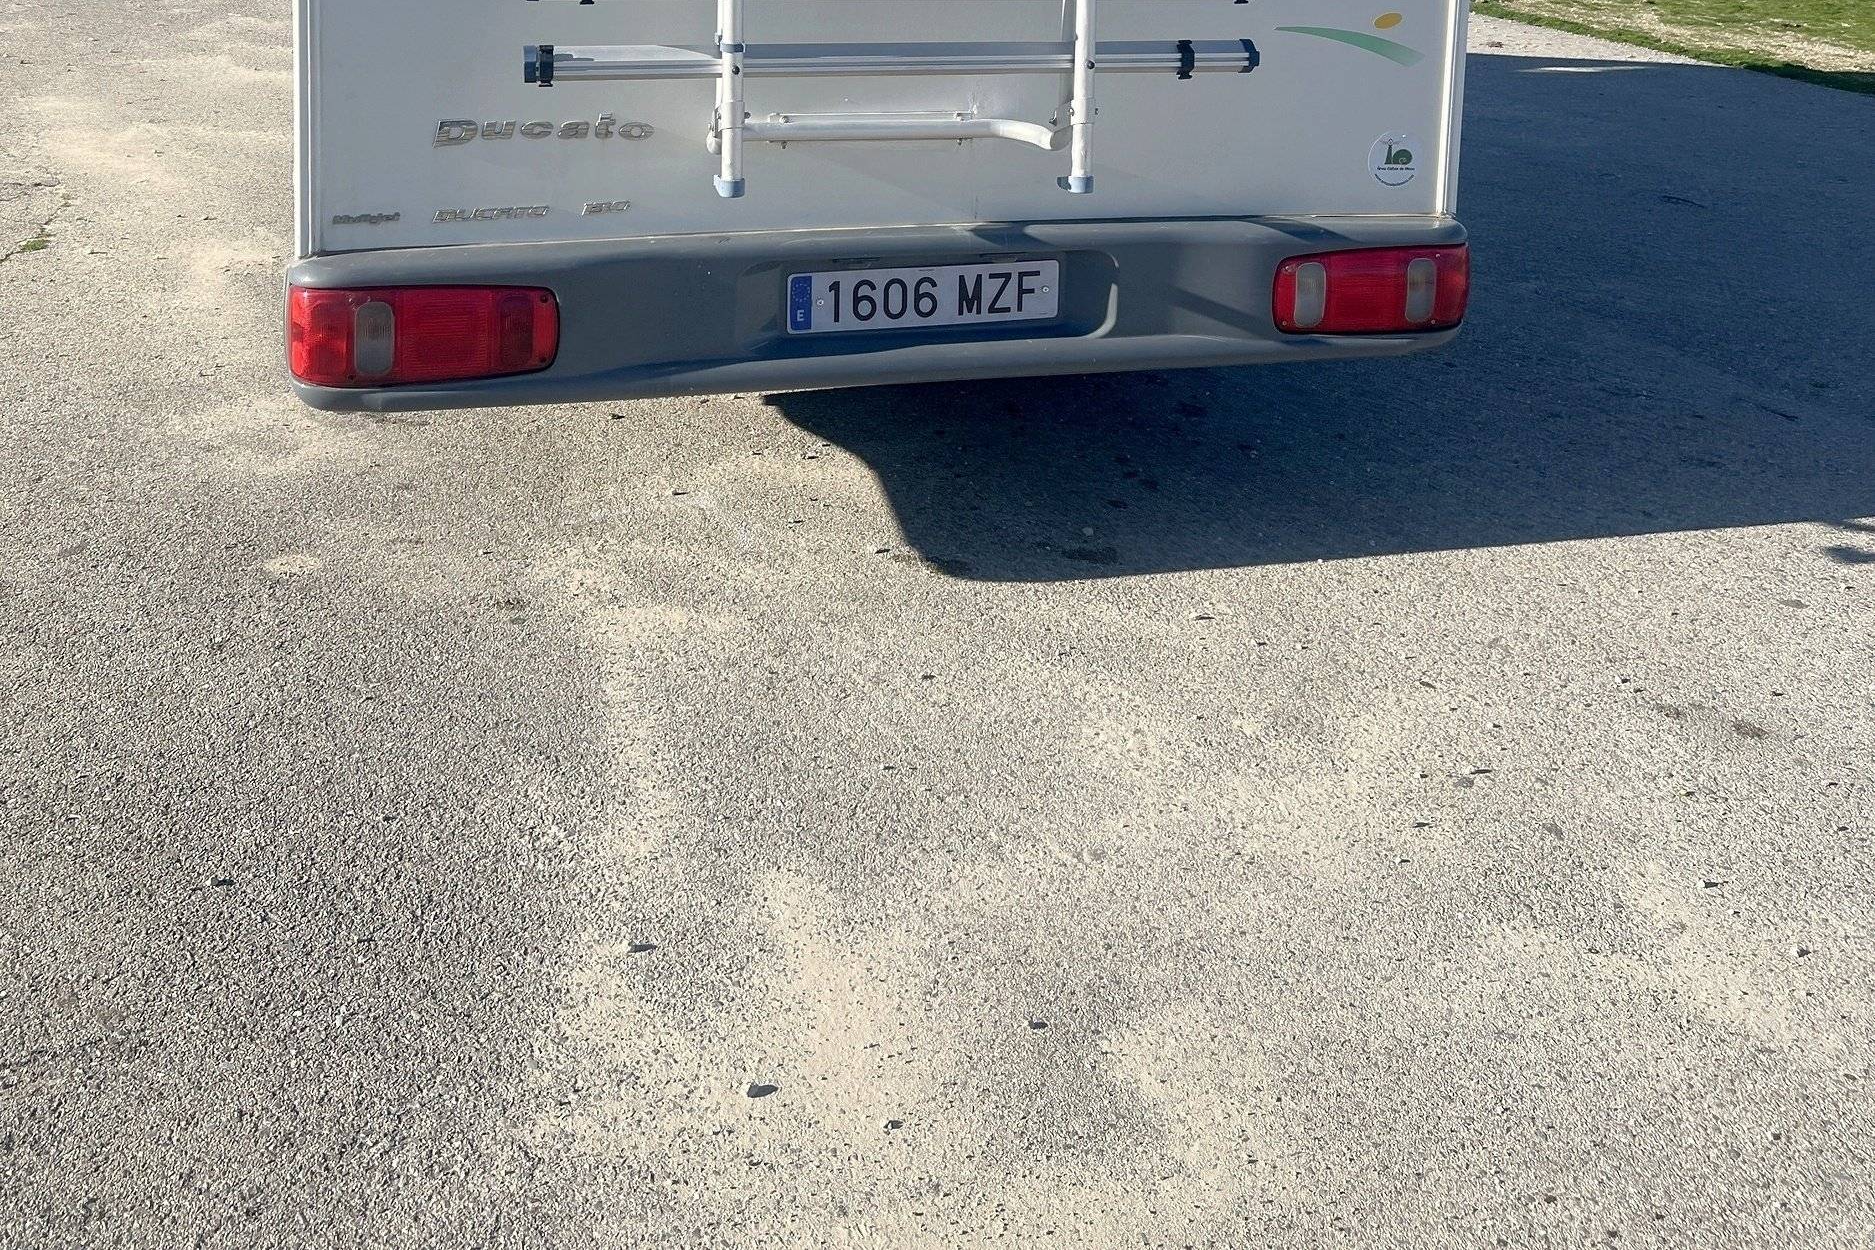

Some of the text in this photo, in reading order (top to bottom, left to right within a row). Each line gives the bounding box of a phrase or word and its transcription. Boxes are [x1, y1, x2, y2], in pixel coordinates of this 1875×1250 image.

[432, 111, 655, 148] Ducato
[796, 309, 805, 322] E
[828, 270, 1042, 324] 1606 MZF
